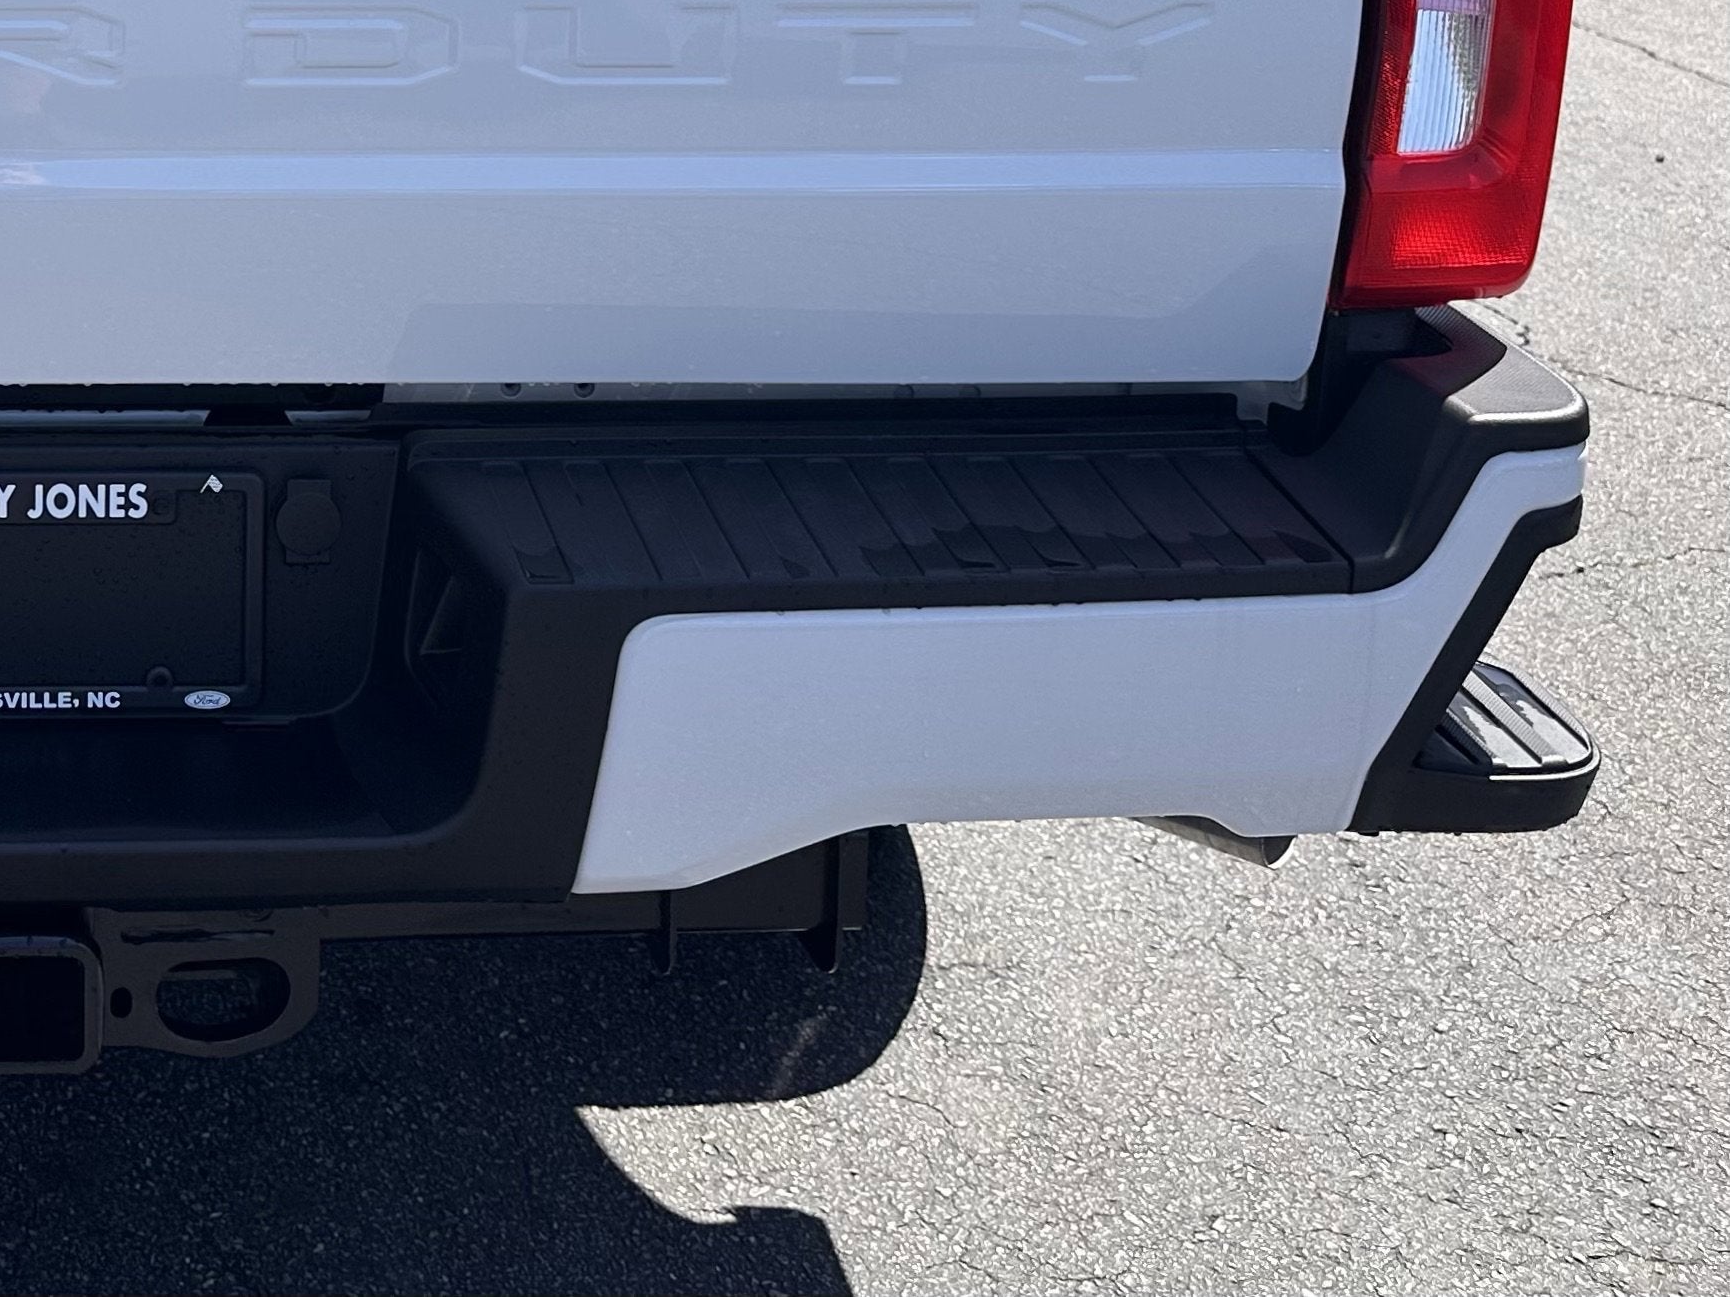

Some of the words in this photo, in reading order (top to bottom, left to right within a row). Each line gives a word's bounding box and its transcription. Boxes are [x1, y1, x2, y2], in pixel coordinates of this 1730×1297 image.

[242, 2, 1214, 87] DUTY
[27, 482, 149, 519] JONES
[87, 692, 121, 709] NC
